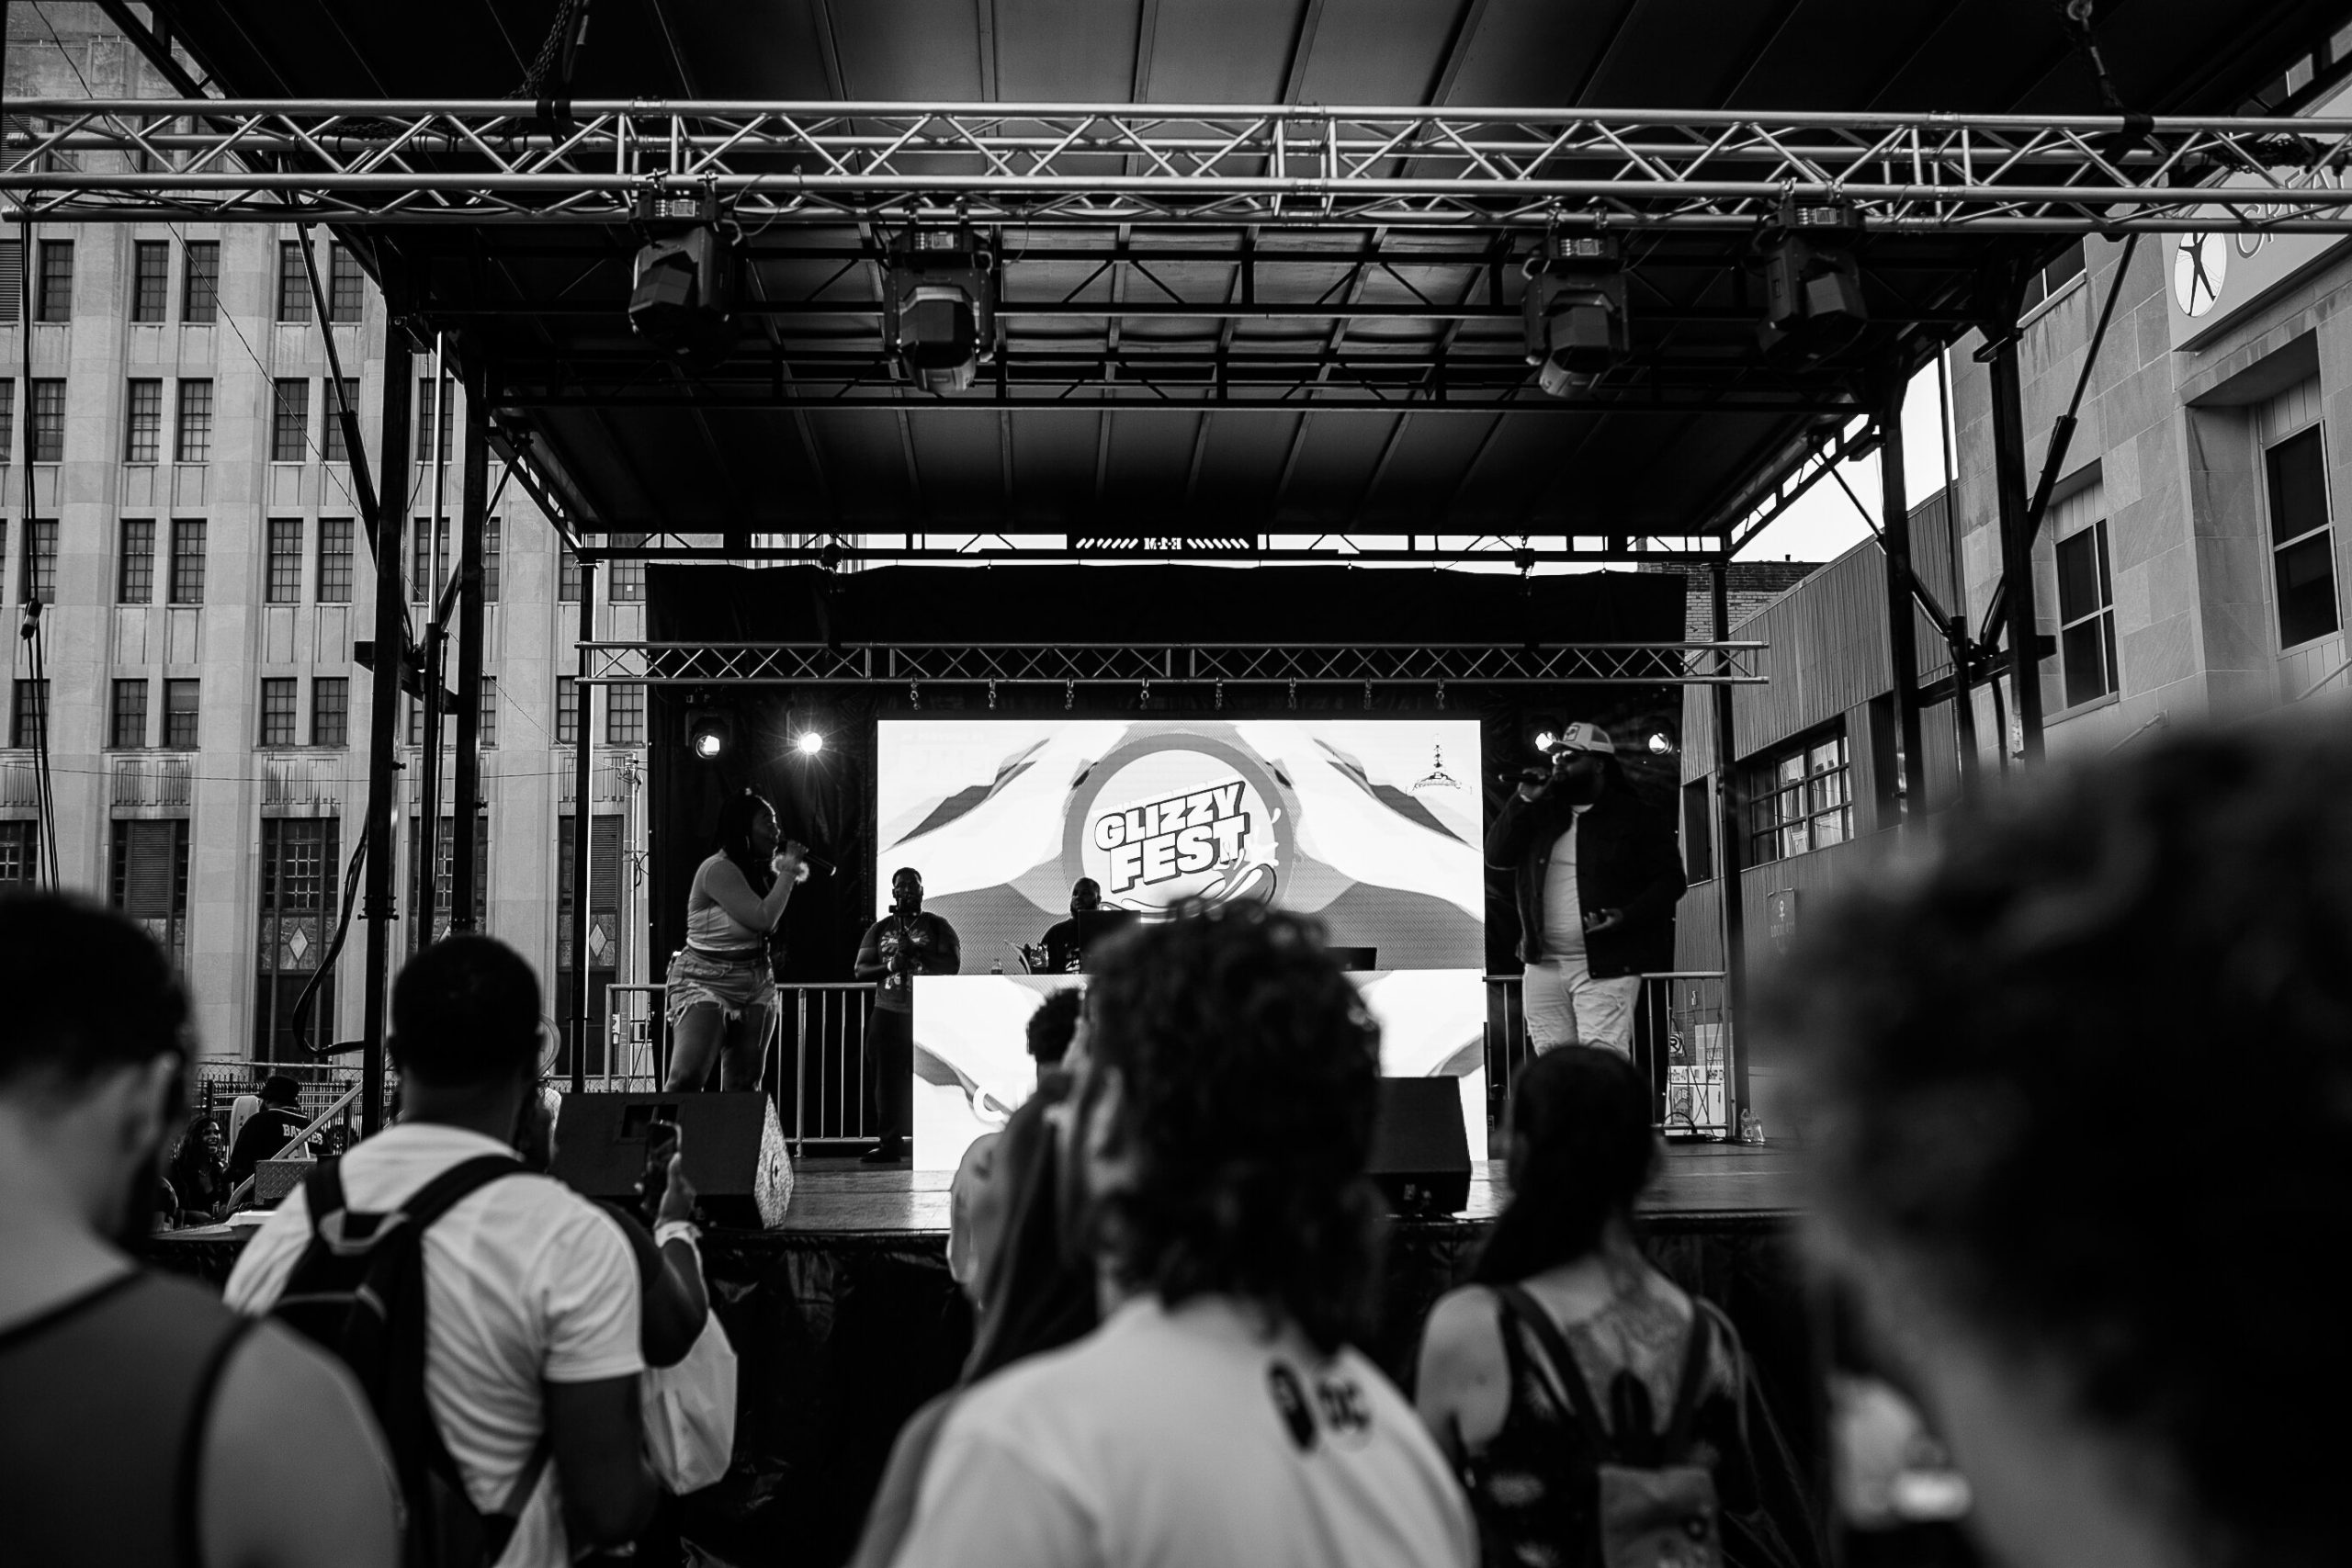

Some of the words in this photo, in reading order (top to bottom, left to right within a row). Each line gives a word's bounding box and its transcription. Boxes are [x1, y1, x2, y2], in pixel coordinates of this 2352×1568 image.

[1094, 781, 1246, 852] GLIZZY
[1110, 812, 1250, 894] FEST
[282, 1123, 322, 1145] BAES
